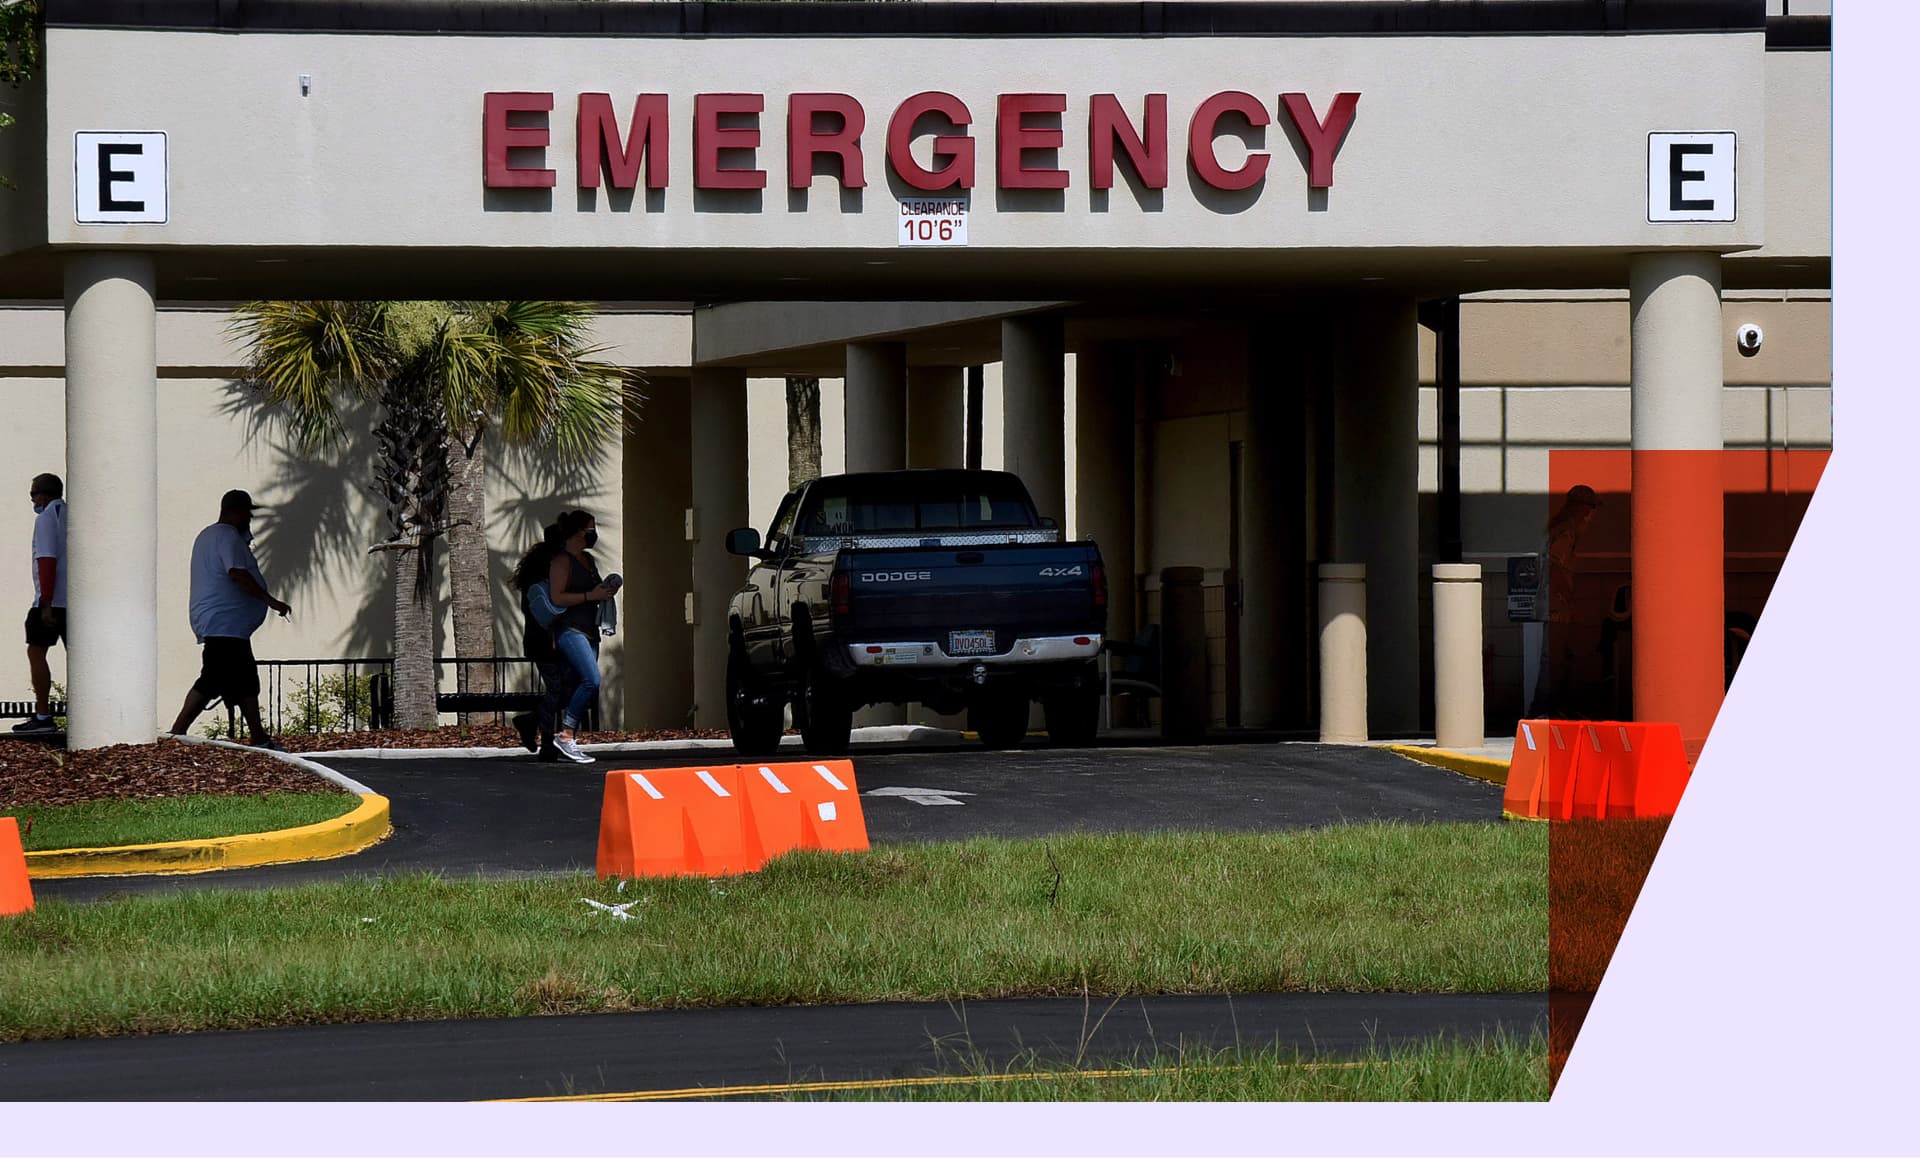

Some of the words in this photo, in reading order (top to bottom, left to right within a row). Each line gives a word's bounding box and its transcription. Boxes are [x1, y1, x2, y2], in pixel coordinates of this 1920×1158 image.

[483, 90, 1361, 191] EMERGENCY
[98, 143, 145, 212] E
[901, 201, 964, 216] CLEARANCE
[1669, 143, 1715, 211] E
[861, 572, 931, 582] DODGE
